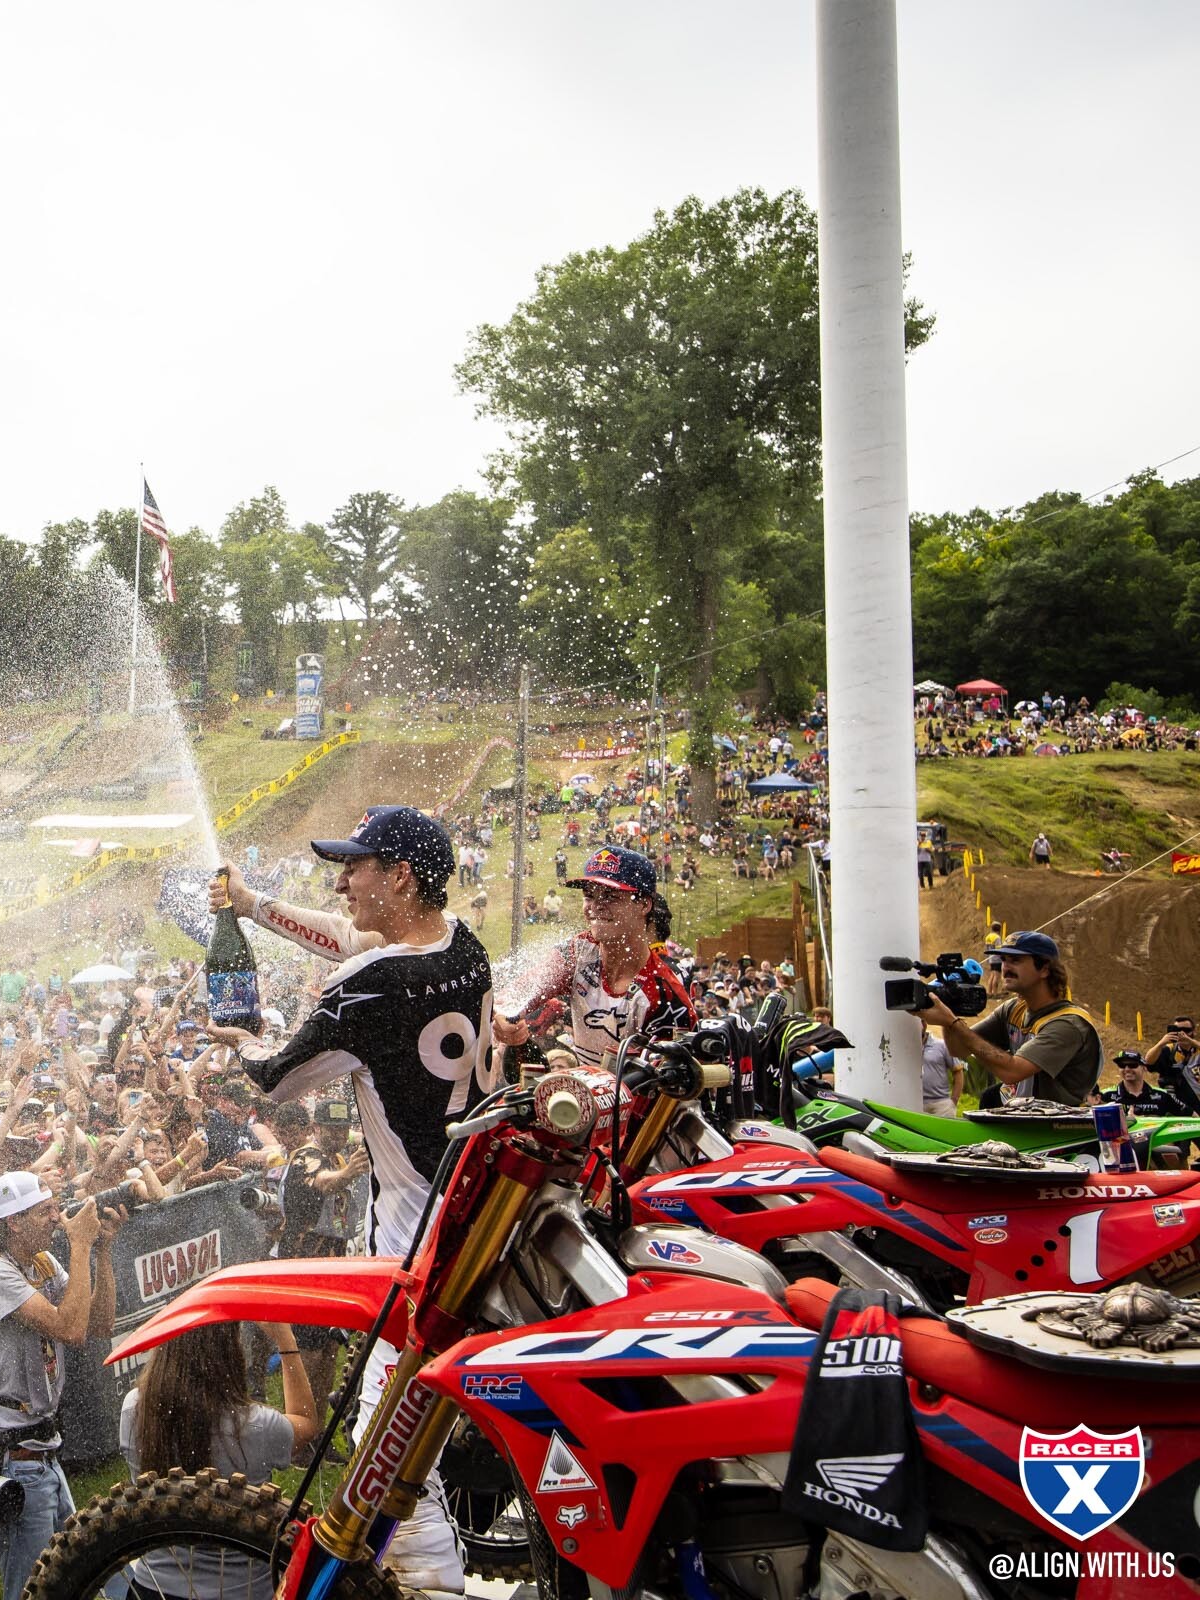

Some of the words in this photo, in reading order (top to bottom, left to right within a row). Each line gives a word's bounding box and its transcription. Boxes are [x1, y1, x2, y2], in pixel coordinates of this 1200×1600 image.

[268, 910, 342, 954] HONDA
[594, 1090, 632, 1111] RENTAL
[743, 1160, 809, 1169] 250R
[647, 1168, 838, 1192] CRF
[1037, 1184, 1157, 1200] HONDA
[651, 1240, 687, 1261] VP
[1064, 1208, 1106, 1285] 1
[142, 1242, 197, 1298] LUCAS
[199, 1233, 219, 1275] OIL
[643, 1310, 774, 1323] 250R
[465, 1326, 818, 1366] CRF
[464, 1375, 523, 1396] HRC
[357, 1375, 436, 1510] SHOWA
[543, 1478, 558, 1487] Pro
[560, 1476, 587, 1485] Honda
[802, 1481, 903, 1529] HONDA
